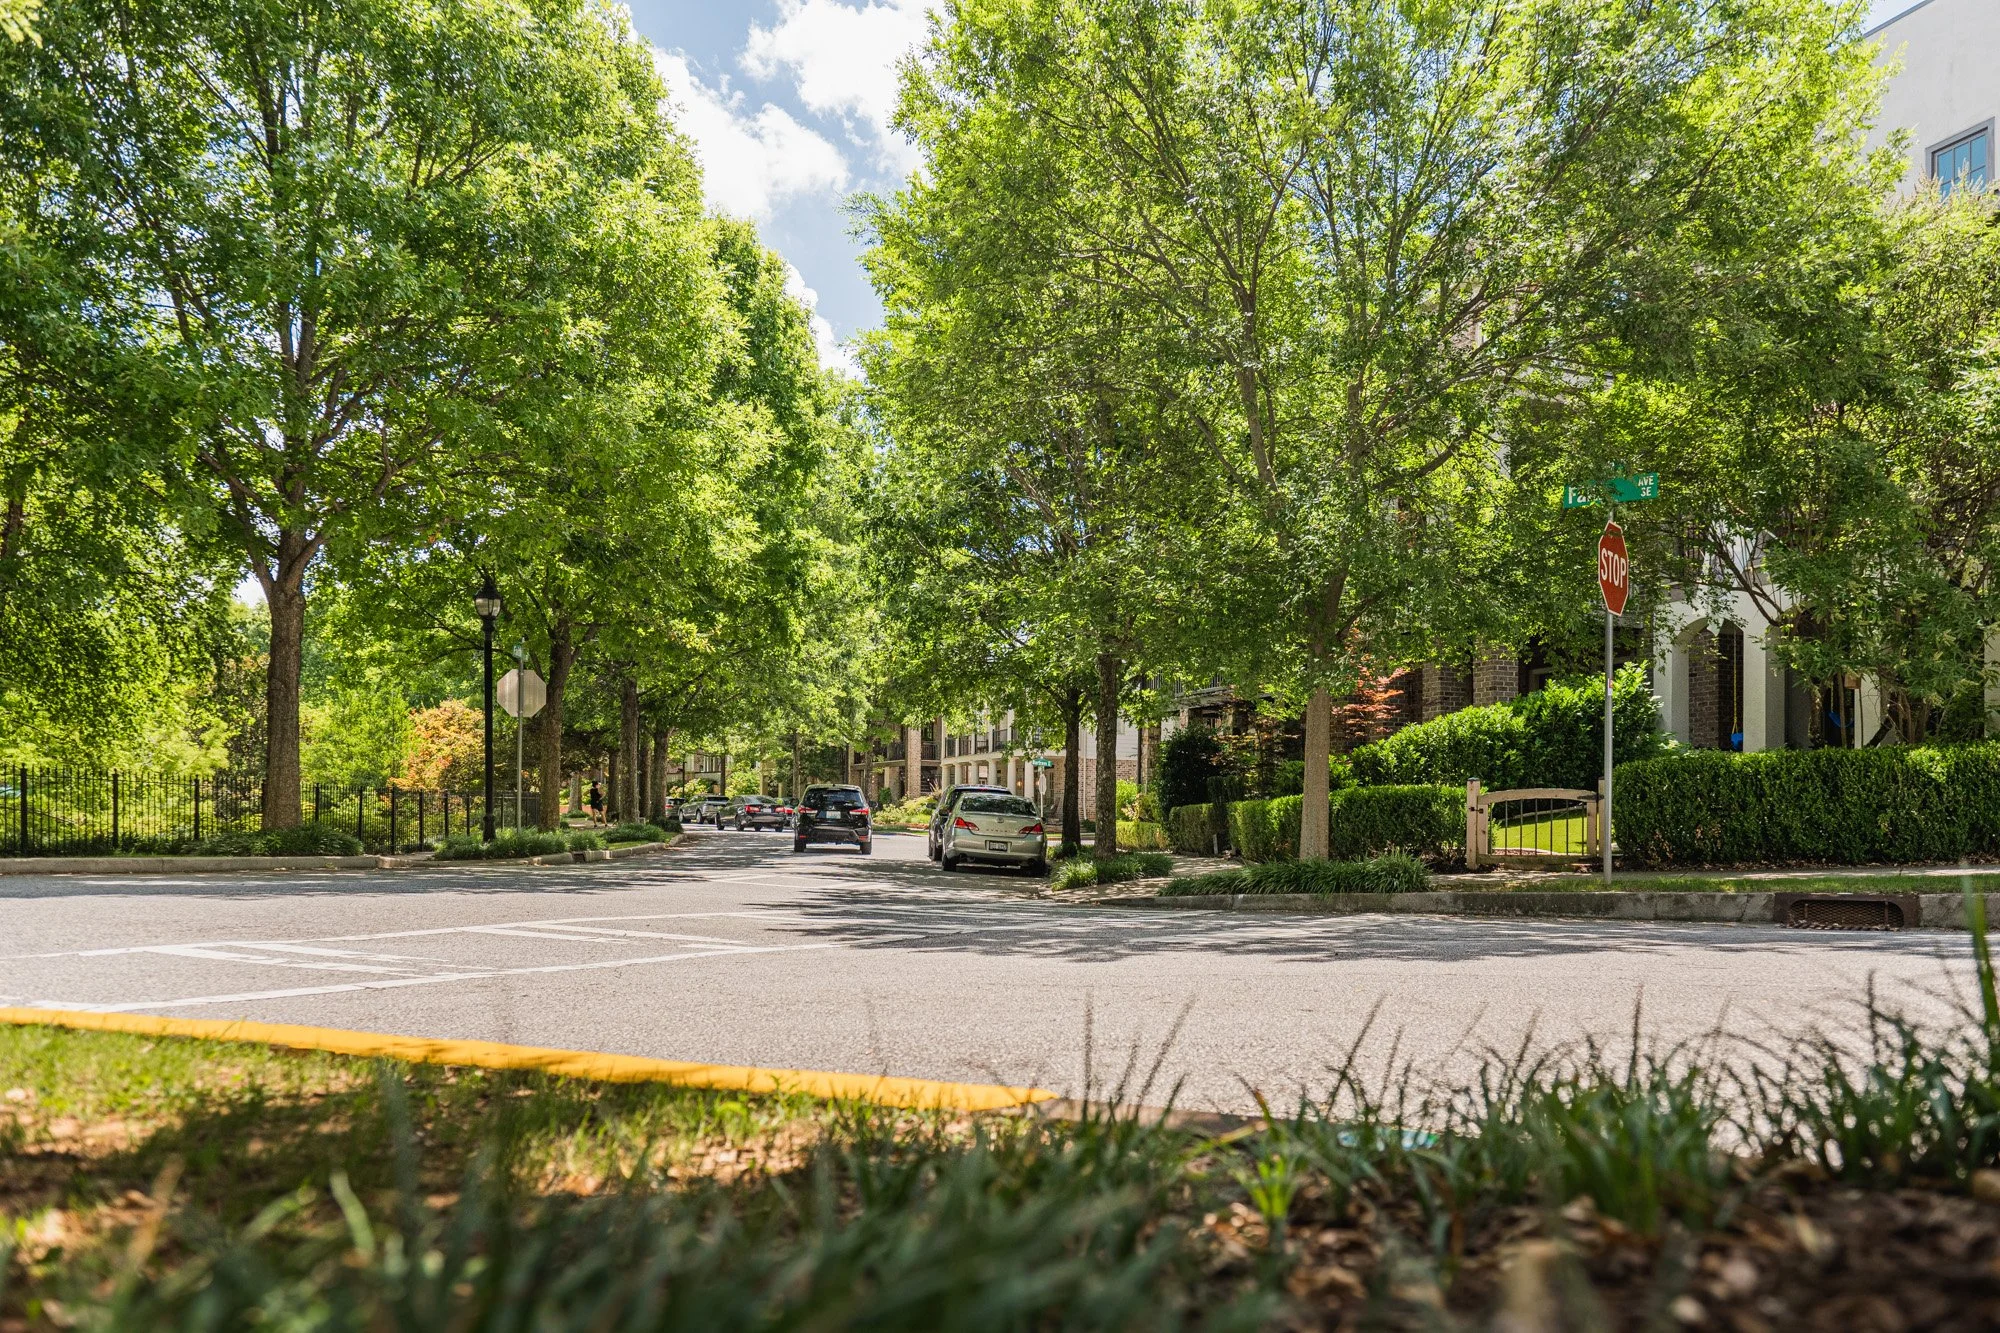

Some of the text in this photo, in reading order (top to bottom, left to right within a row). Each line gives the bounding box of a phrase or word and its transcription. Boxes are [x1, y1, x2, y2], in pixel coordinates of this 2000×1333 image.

[1637, 475, 1654, 487] AVE
[1641, 486, 1652, 497] SE
[1601, 547, 1626, 588] STOP
